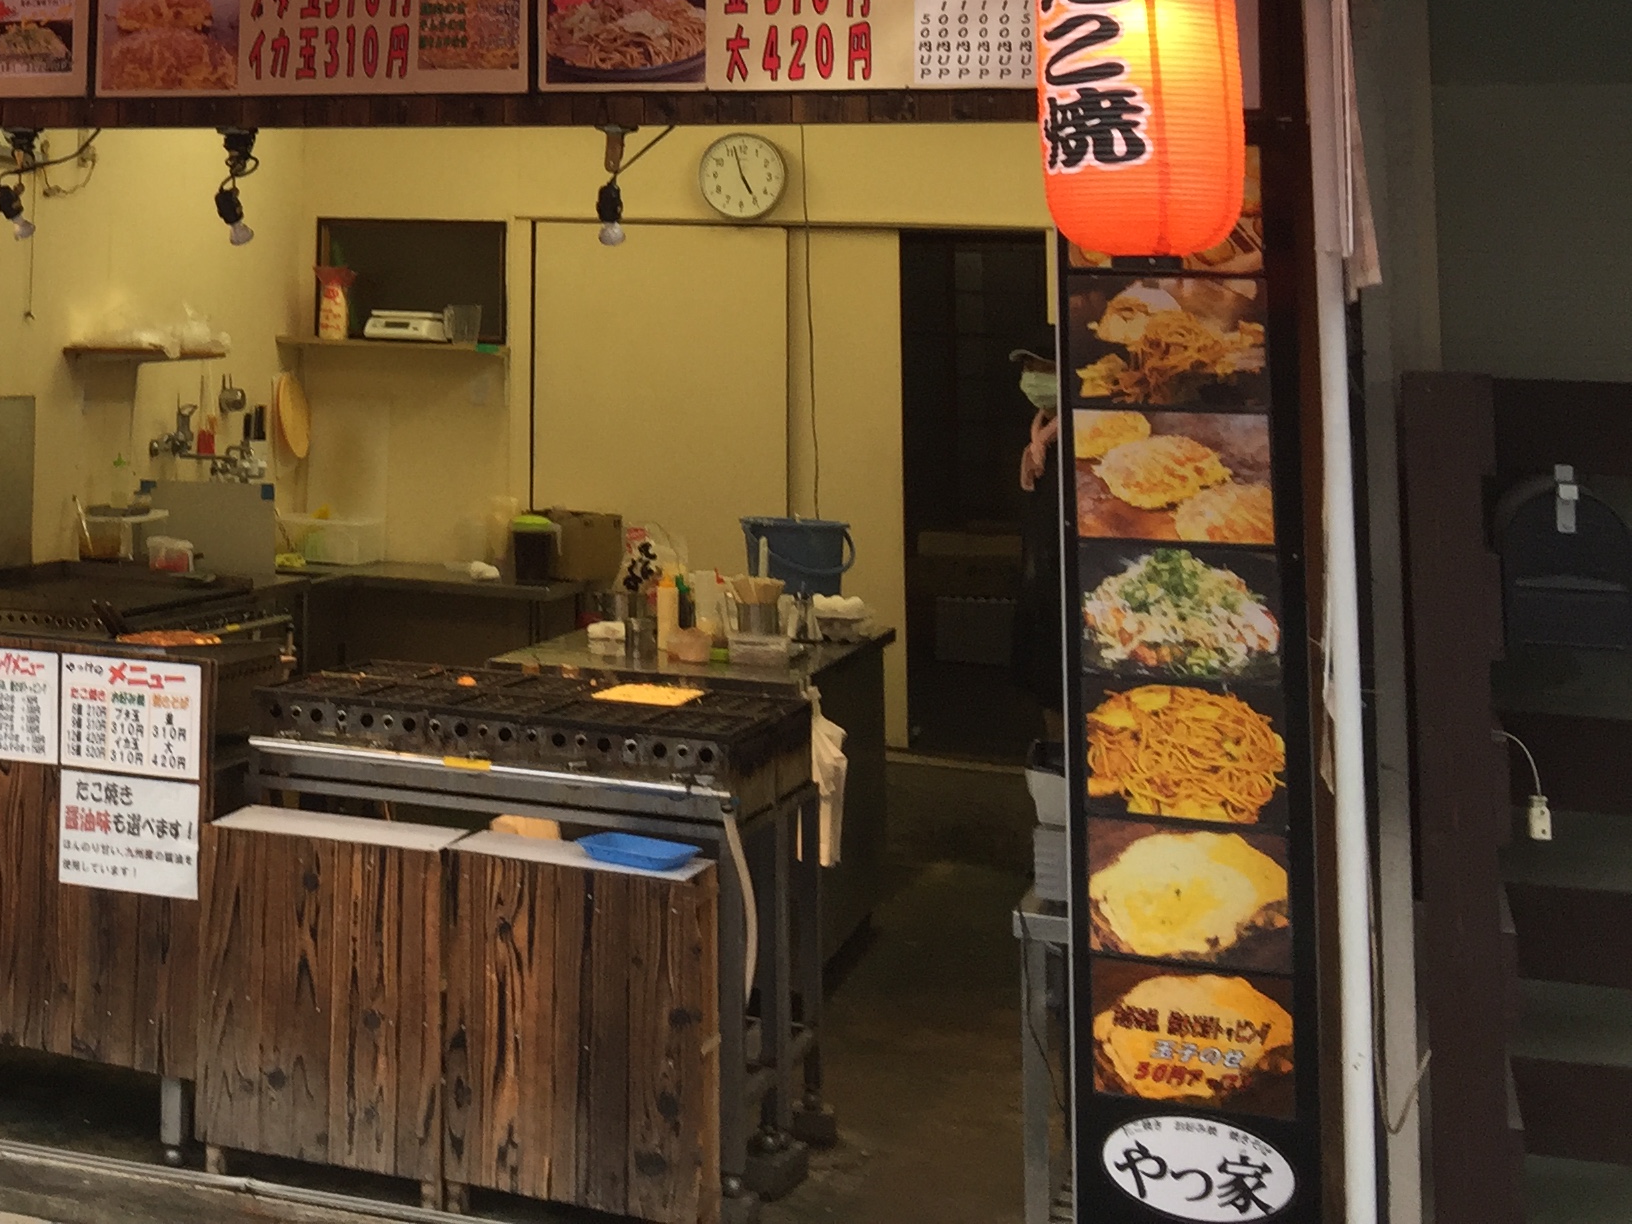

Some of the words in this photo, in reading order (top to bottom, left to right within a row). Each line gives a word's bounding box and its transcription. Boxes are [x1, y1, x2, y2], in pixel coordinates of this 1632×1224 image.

[108, 662, 186, 689] メニュー
[111, 721, 145, 738] 310円
[152, 724, 187, 742] 310円
[110, 749, 144, 766] 310円
[151, 753, 186, 771] 420円
[76, 778, 134, 806] たこ焼き
[1150, 1039, 1247, 1068] 玉子のせ
